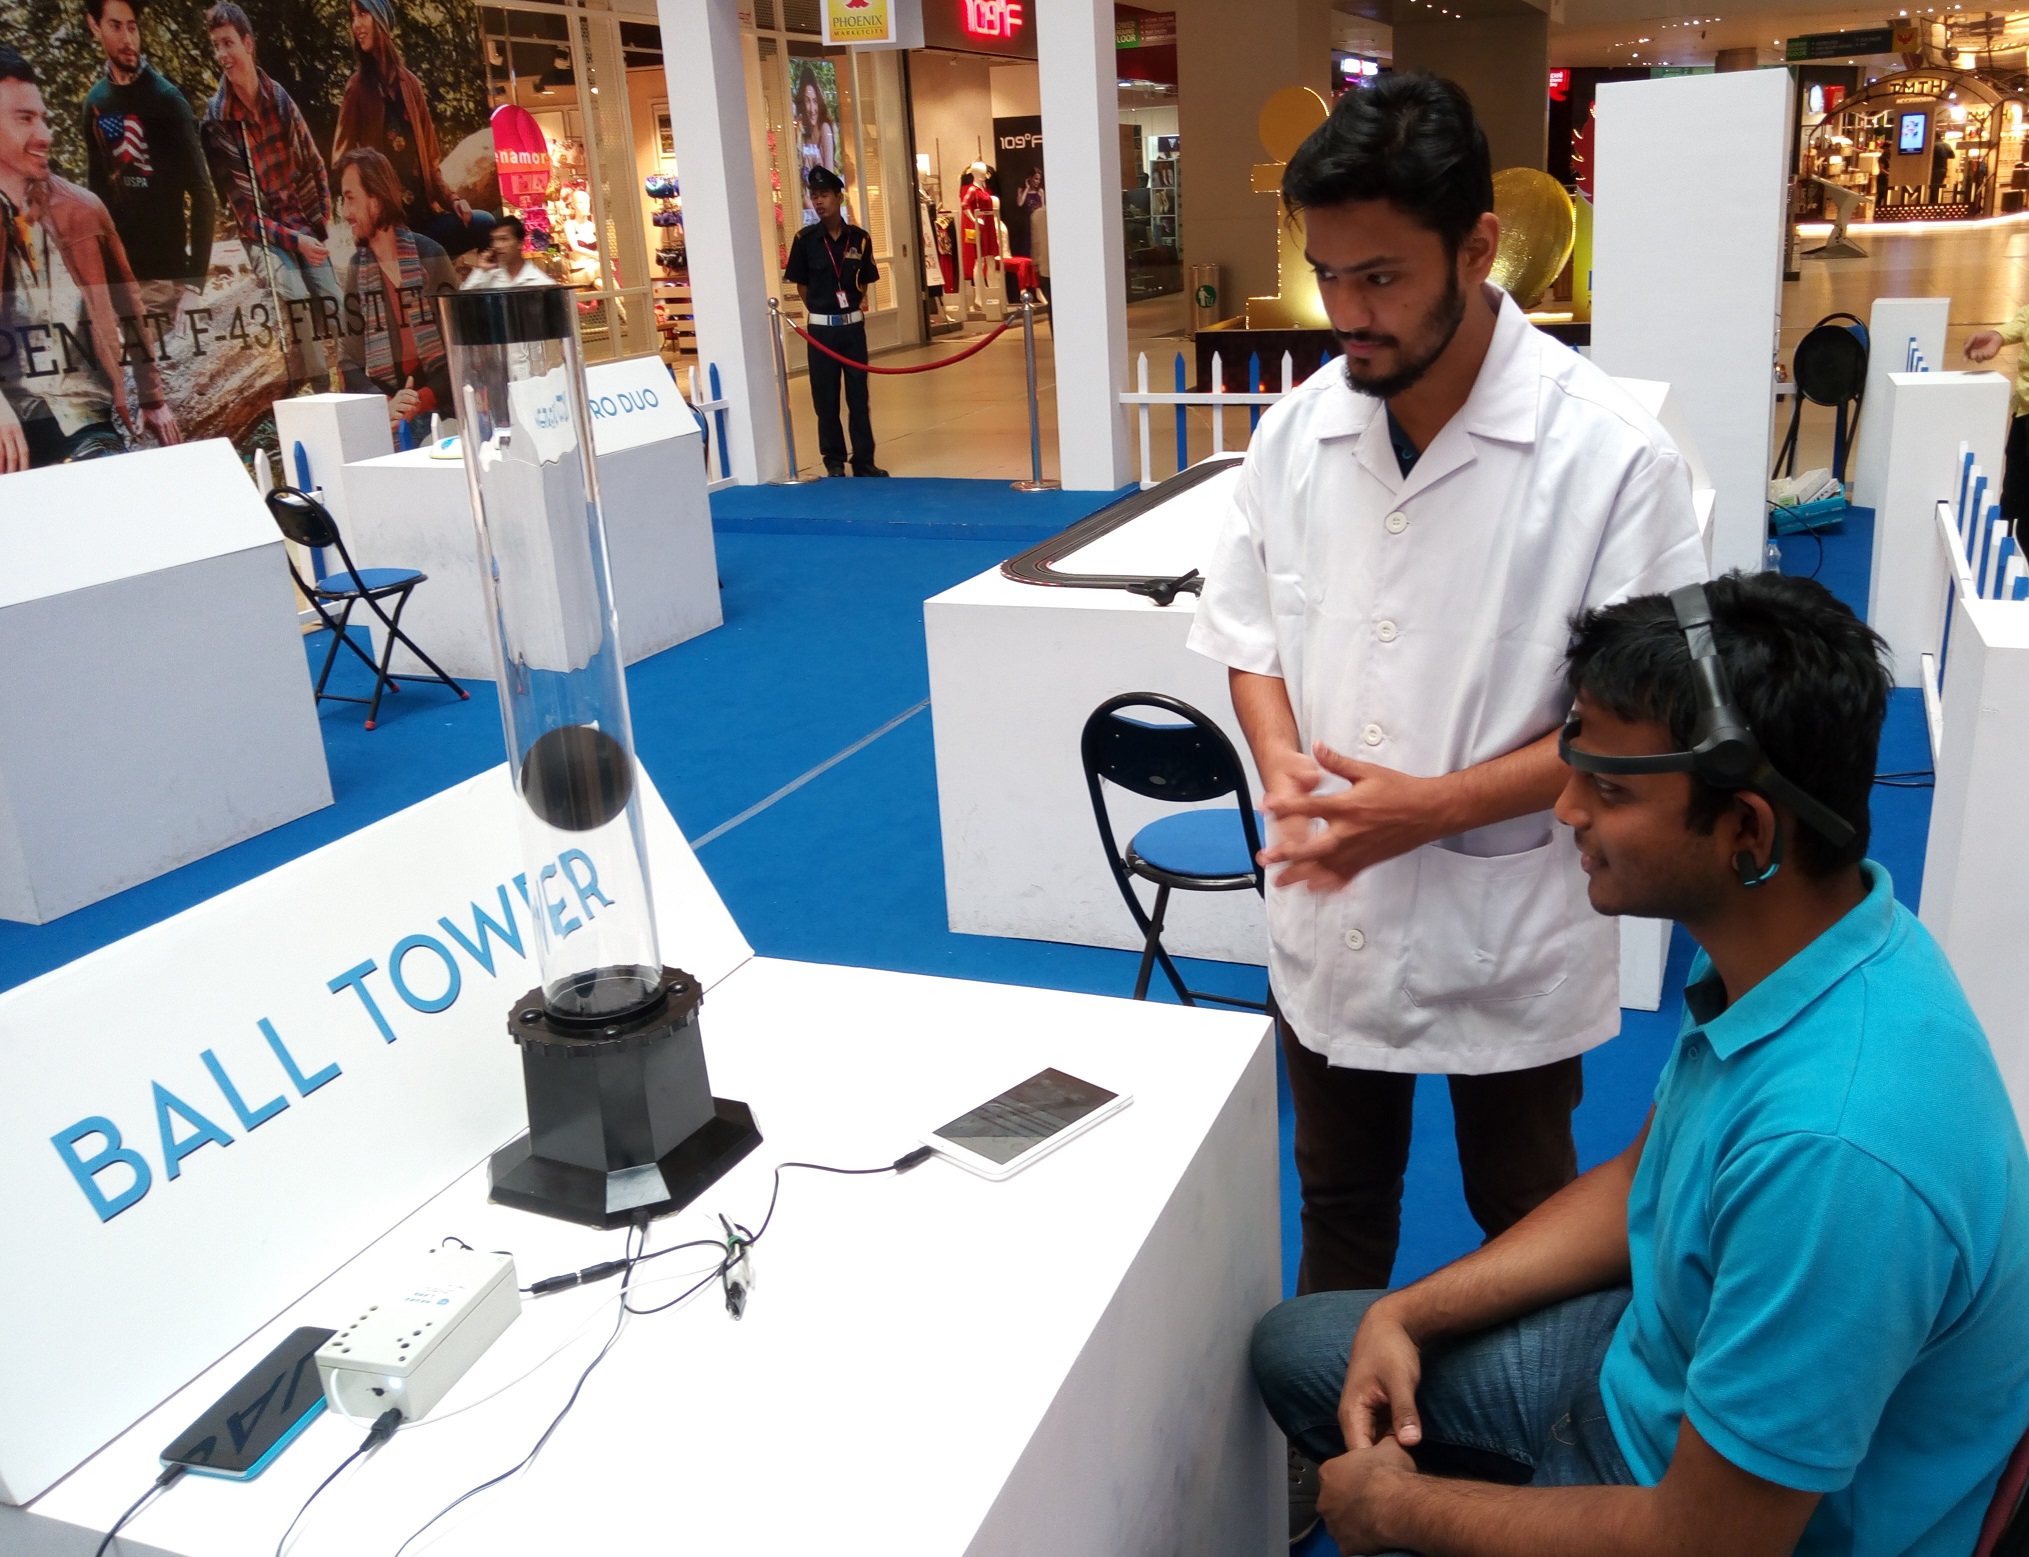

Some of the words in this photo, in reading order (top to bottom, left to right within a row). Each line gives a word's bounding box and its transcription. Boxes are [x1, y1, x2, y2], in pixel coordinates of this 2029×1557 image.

[832, 15, 882, 27] PHOENIX
[1890, 79, 1944, 94] TMTH
[119, 312, 172, 367] AT
[286, 289, 386, 345] FIRST
[617, 388, 659, 413] DUO
[49, 1016, 343, 1223] BALL
[326, 848, 615, 1045] TOWER
